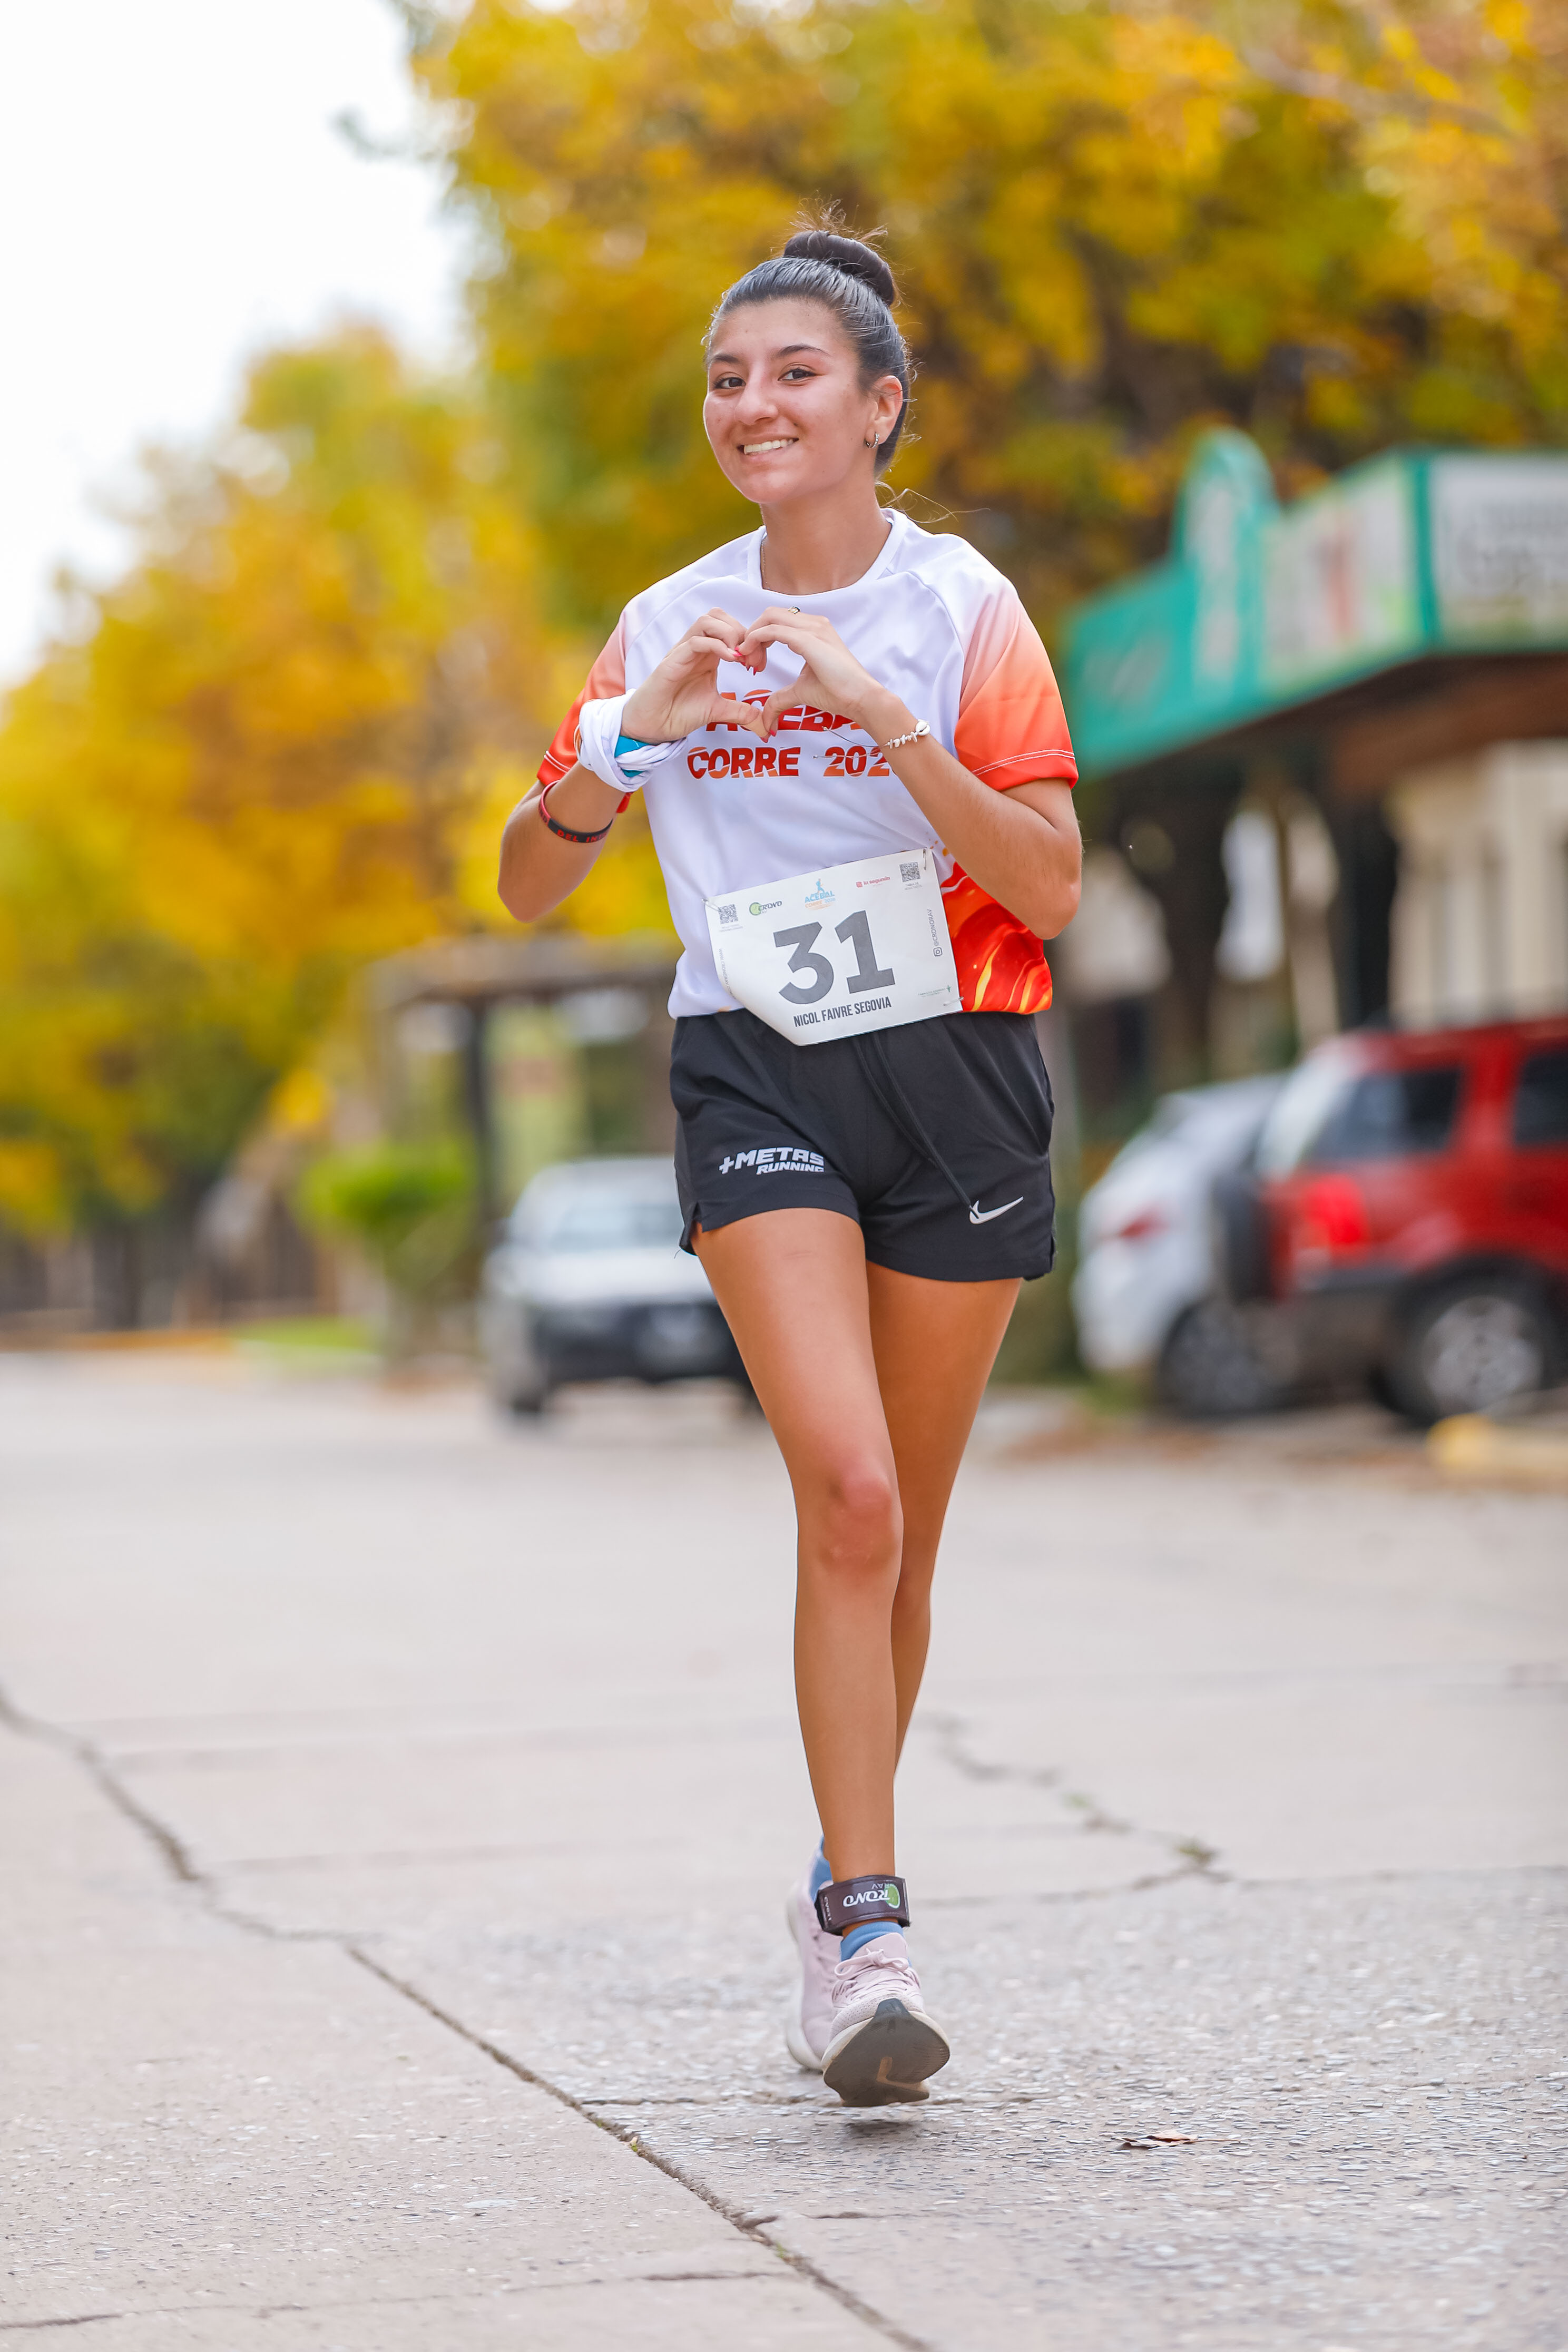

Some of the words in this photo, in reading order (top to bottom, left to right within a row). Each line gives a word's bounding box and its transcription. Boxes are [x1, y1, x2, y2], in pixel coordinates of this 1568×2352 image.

[687, 746, 801, 779] CORRE
[823, 745, 895, 777] 202
[556, 829, 579, 842] DEL
[773, 910, 896, 1005] 31
[793, 1011, 821, 1027] NICOL
[821, 1004, 854, 1022] FAIVRE
[854, 996, 892, 1015] SEGOVIA
[756, 1161, 825, 1175] RUNNING
